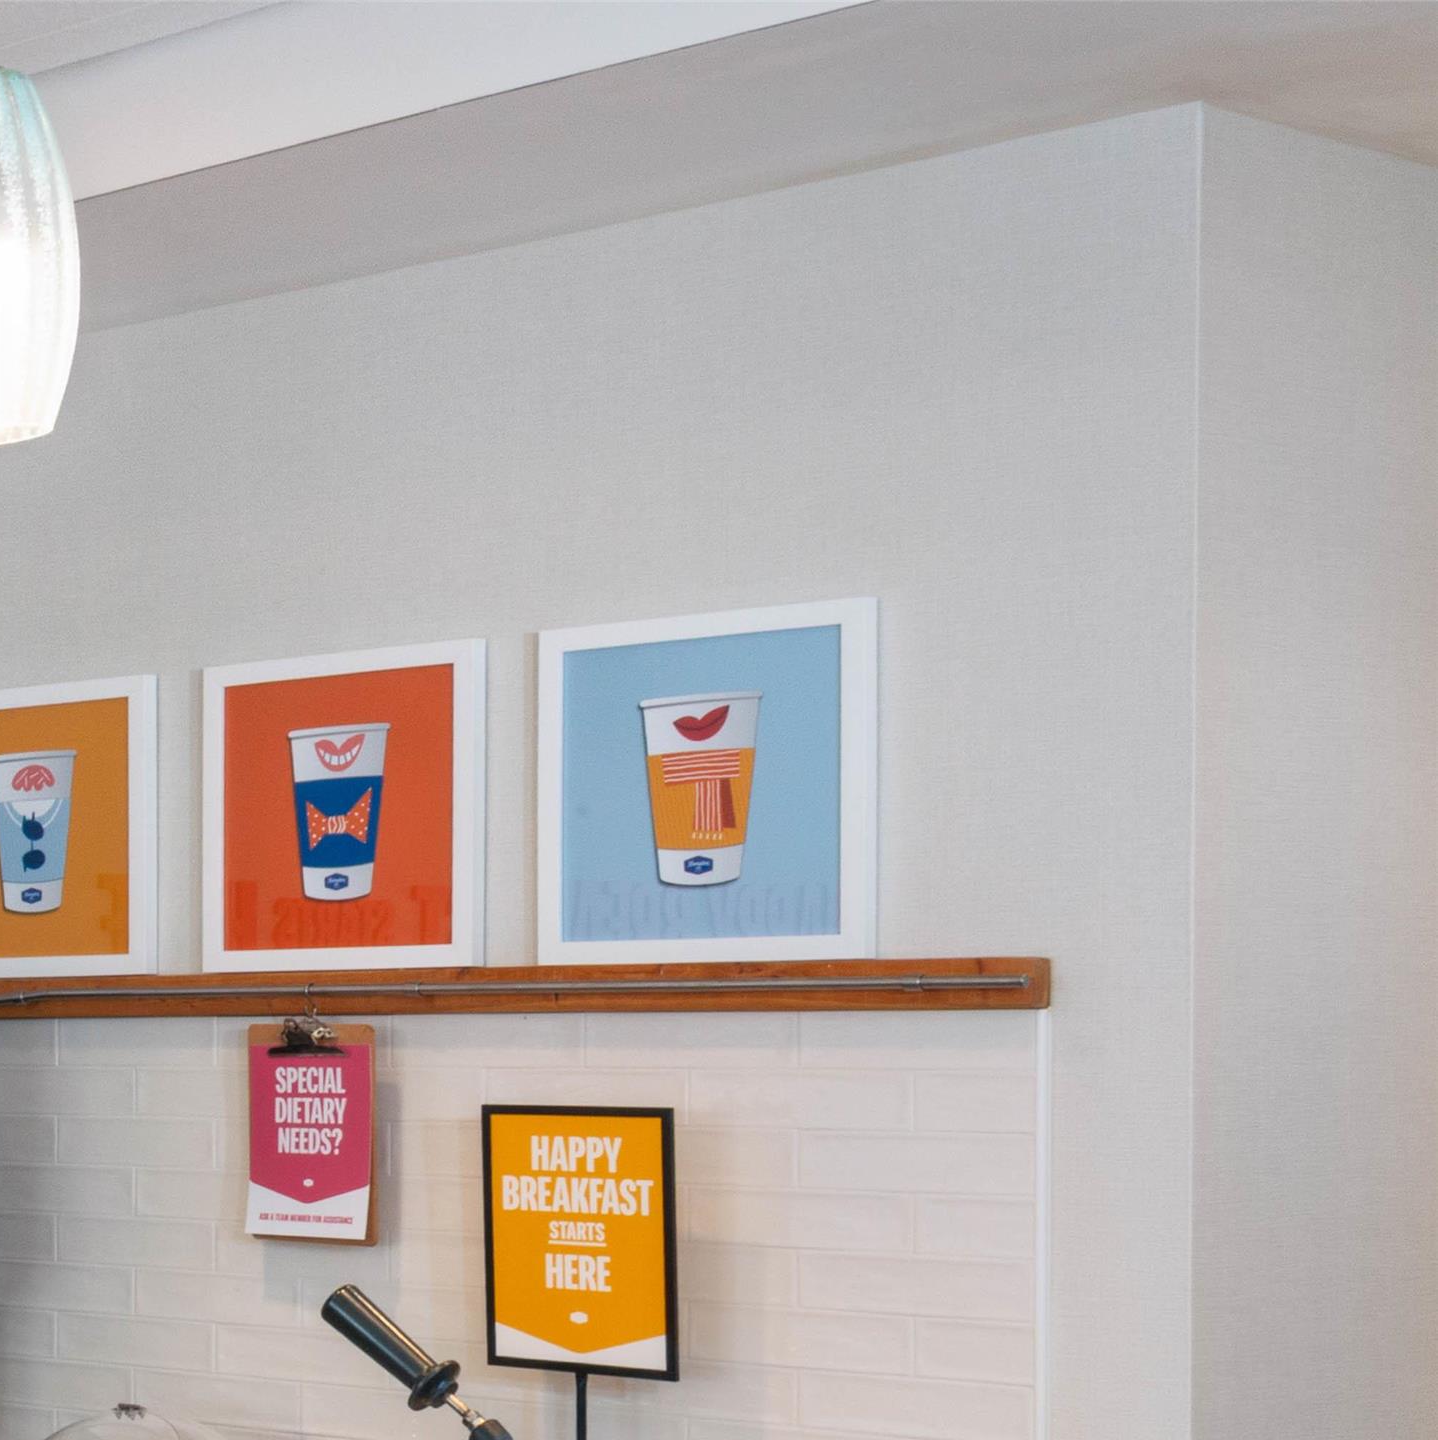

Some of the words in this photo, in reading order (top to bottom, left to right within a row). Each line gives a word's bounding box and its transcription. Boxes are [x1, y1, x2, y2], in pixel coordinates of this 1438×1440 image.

[275, 1067, 345, 1094] SPECIAL
[274, 1097, 347, 1124] DIETARY
[278, 1128, 343, 1155] NEEDS?
[531, 1135, 622, 1173] HAPPY
[502, 1175, 654, 1216] BREAKFAST
[548, 1220, 605, 1241] STARTS
[545, 1253, 612, 1292] HERE
